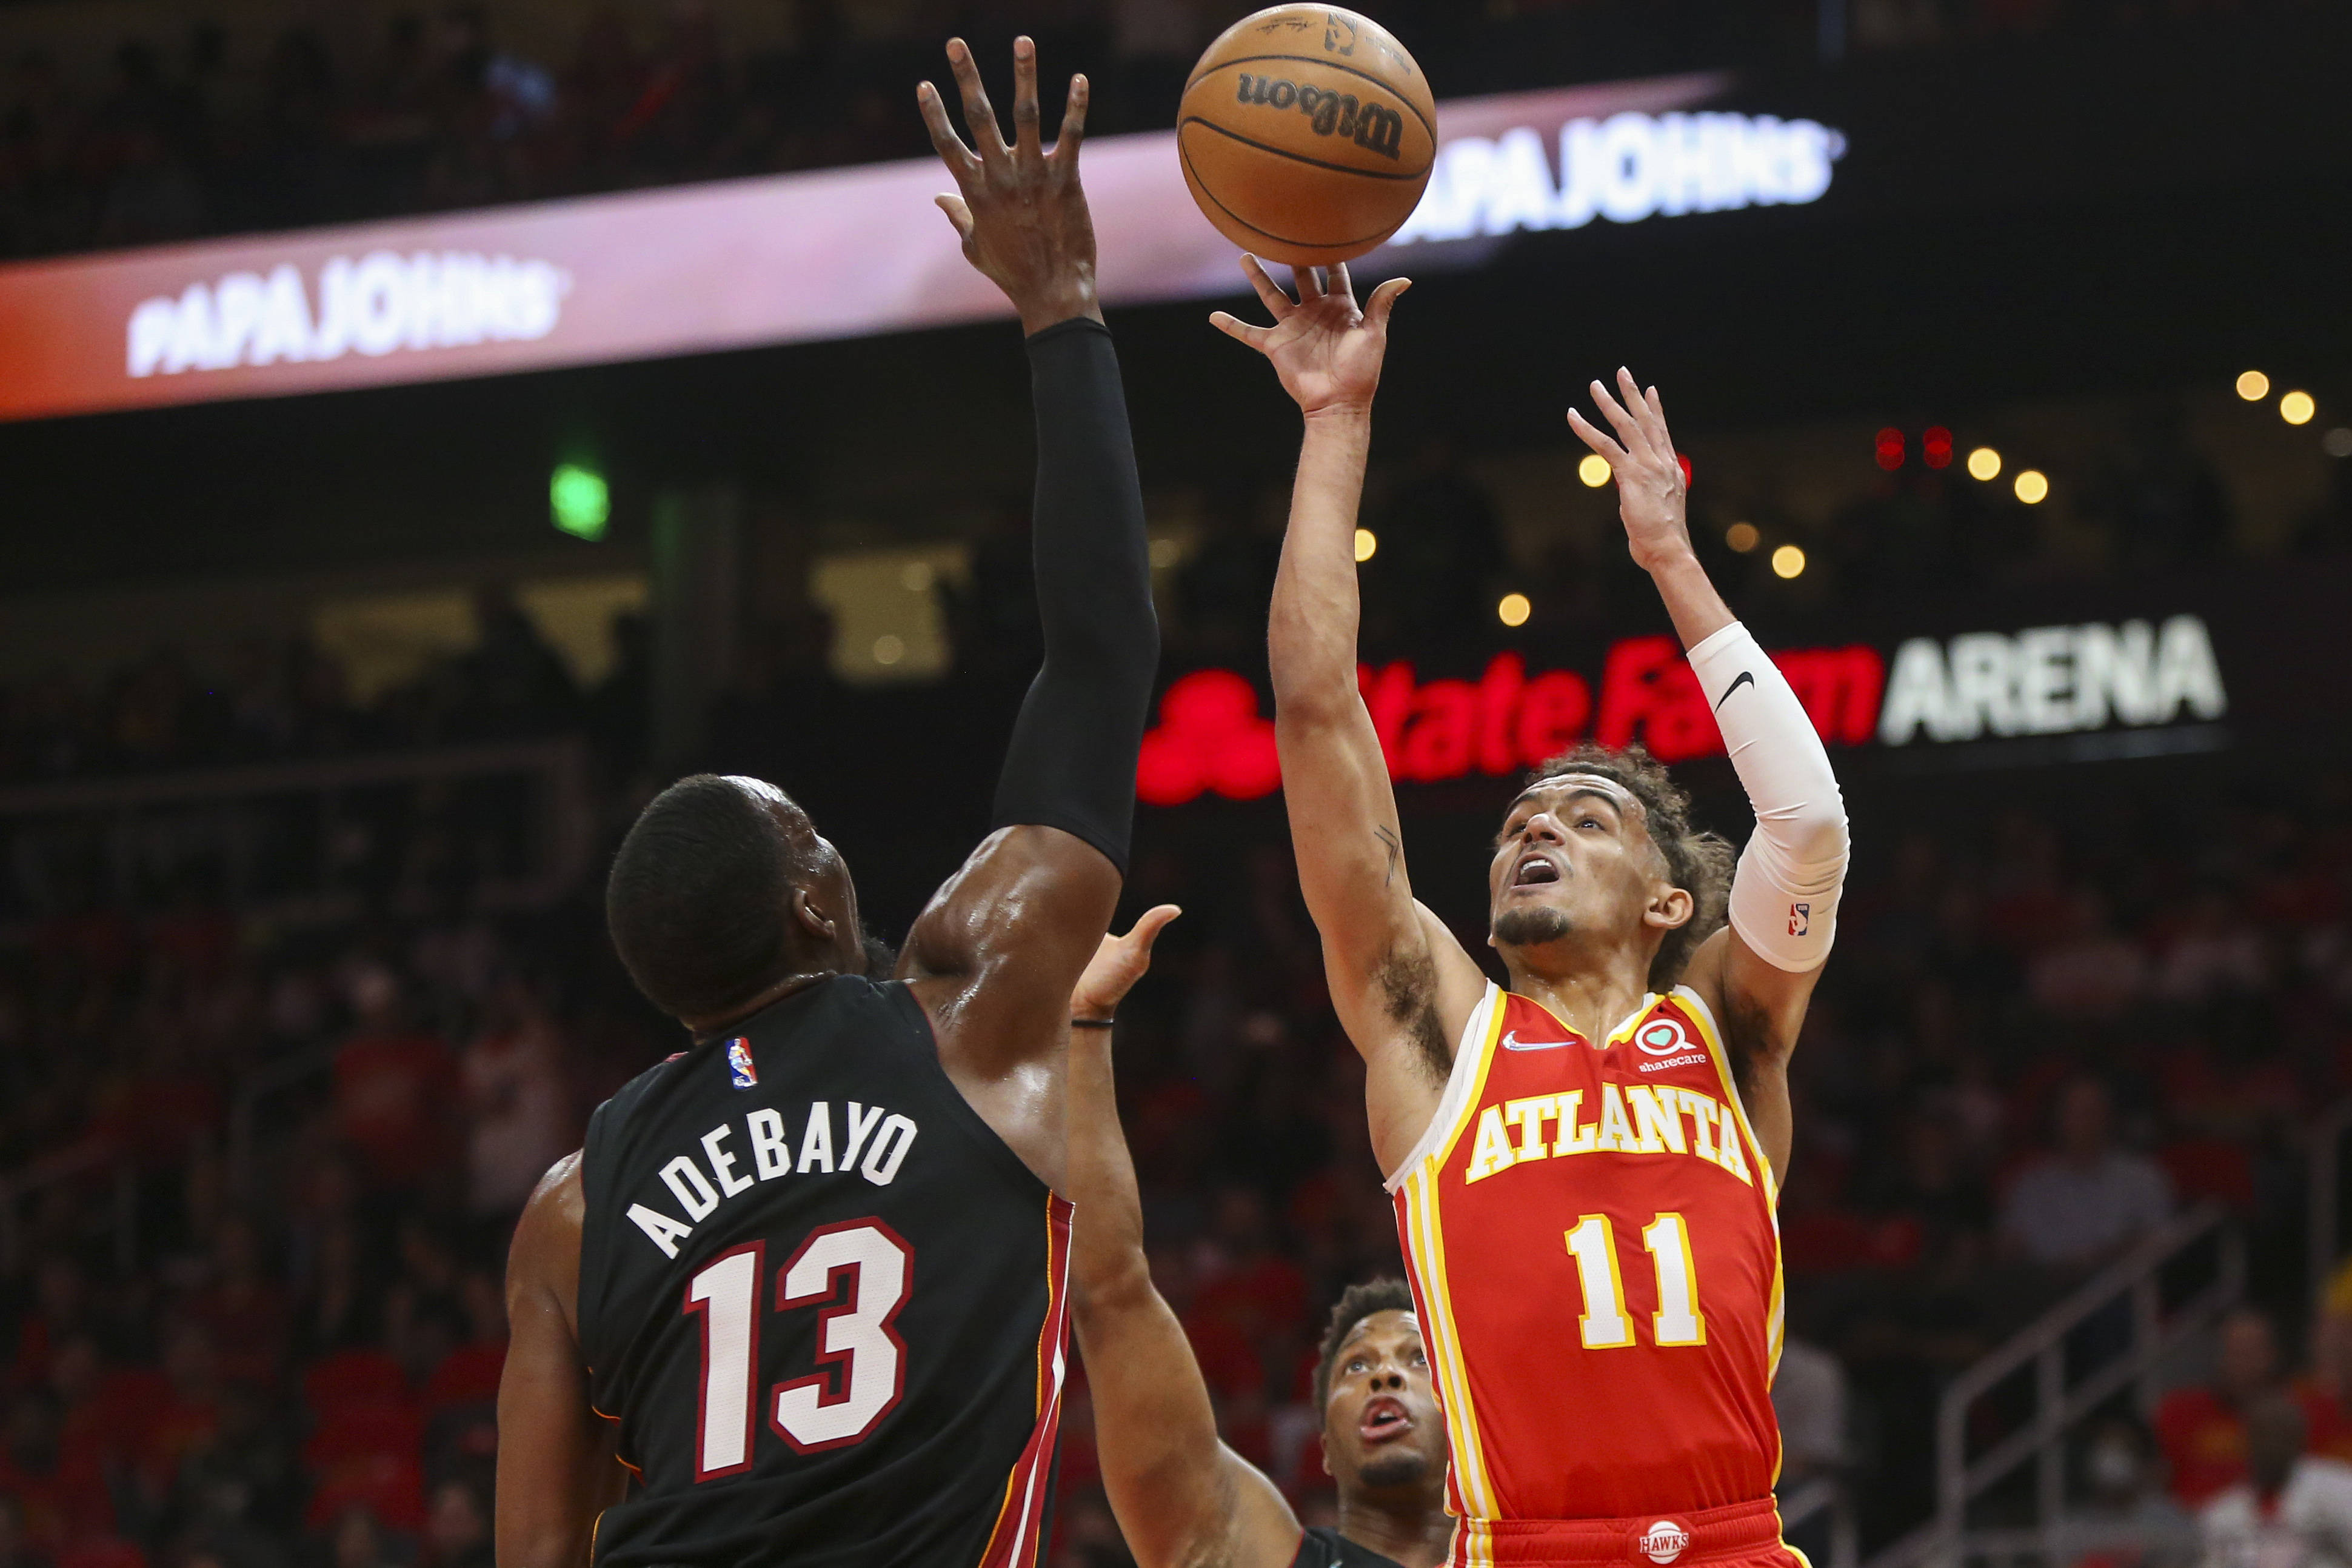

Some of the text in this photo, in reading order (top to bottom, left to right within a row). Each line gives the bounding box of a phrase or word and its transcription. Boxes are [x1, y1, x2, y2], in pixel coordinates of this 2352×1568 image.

[1236, 72, 1404, 161] Wilson
[1357, 650, 1592, 783] tate
[1880, 612, 2228, 747] ARENA
[1639, 1053, 1706, 1073] sharecare
[626, 1101, 918, 1260] ADEBAYO
[1465, 1081, 1754, 1188] ATLANTA
[1563, 1212, 1708, 1350] 11
[681, 1215, 916, 1485] 13
[1639, 1532, 1689, 1553] HAWKS
